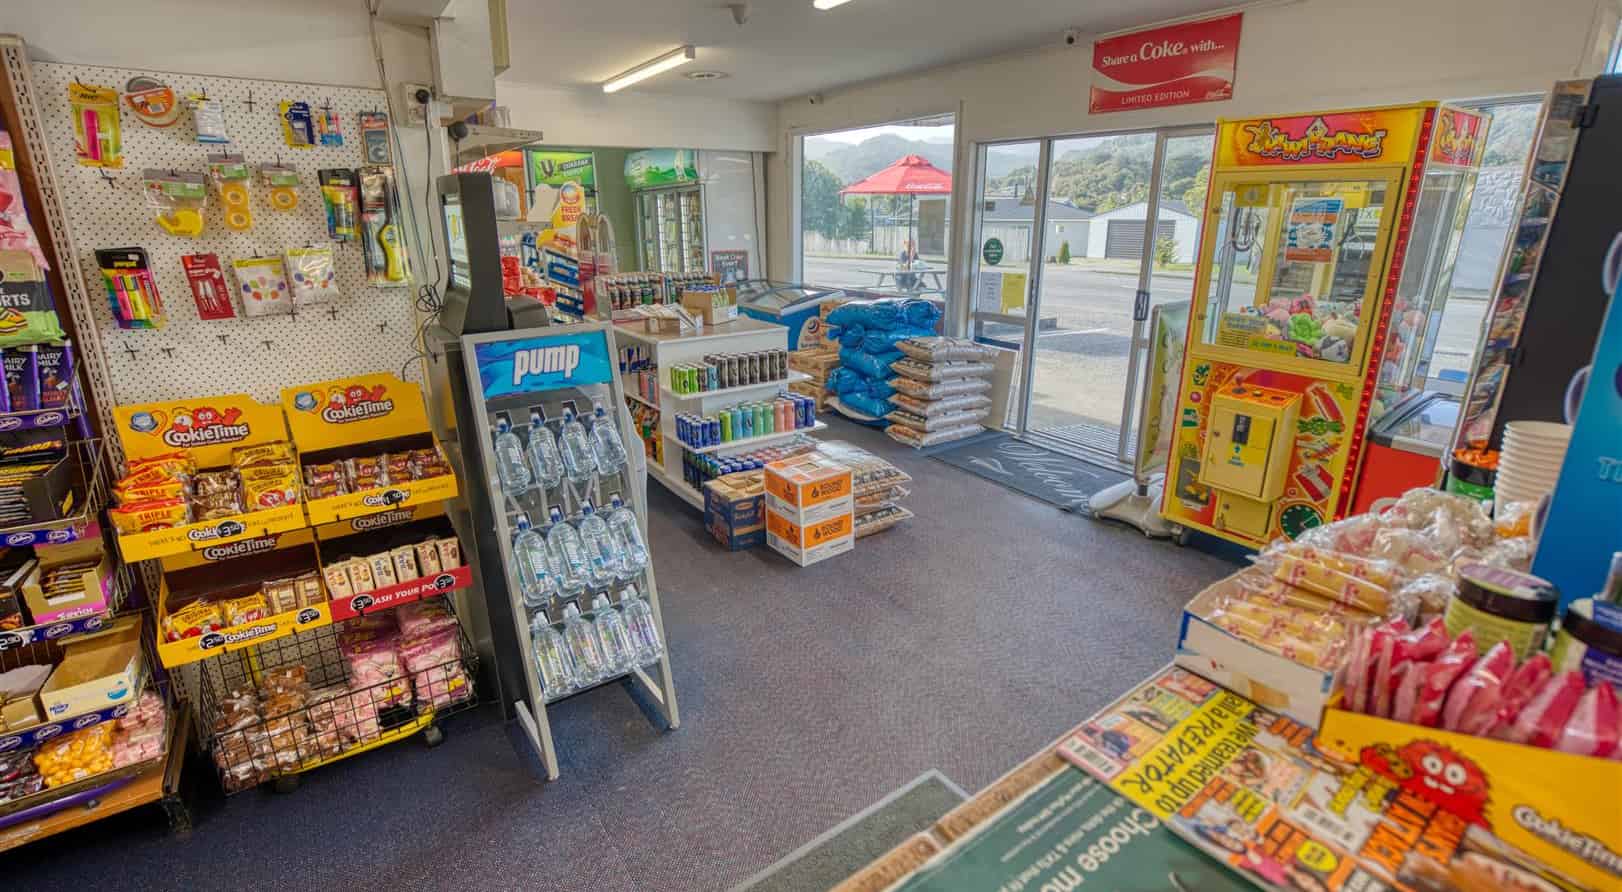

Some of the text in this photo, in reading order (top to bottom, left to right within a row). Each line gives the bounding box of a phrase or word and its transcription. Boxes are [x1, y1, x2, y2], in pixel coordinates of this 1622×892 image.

[1103, 54, 1130, 66] Share
[1121, 89, 1191, 105] LIMITED EDITION
[513, 345, 580, 385] pump
[322, 399, 393, 422] CookieTime
[164, 423, 249, 446] CookieTime
[352, 511, 412, 530] CookieTime
[203, 536, 276, 560] CookieTime
[395, 587, 420, 599] YOUR
[224, 624, 277, 642] CookieTime
[1122, 712, 1220, 795] PREDATOR
[1188, 734, 1241, 785] teamed
[1169, 774, 1197, 803] up
[1153, 792, 1178, 817] to
[1075, 807, 1158, 873] Choose
